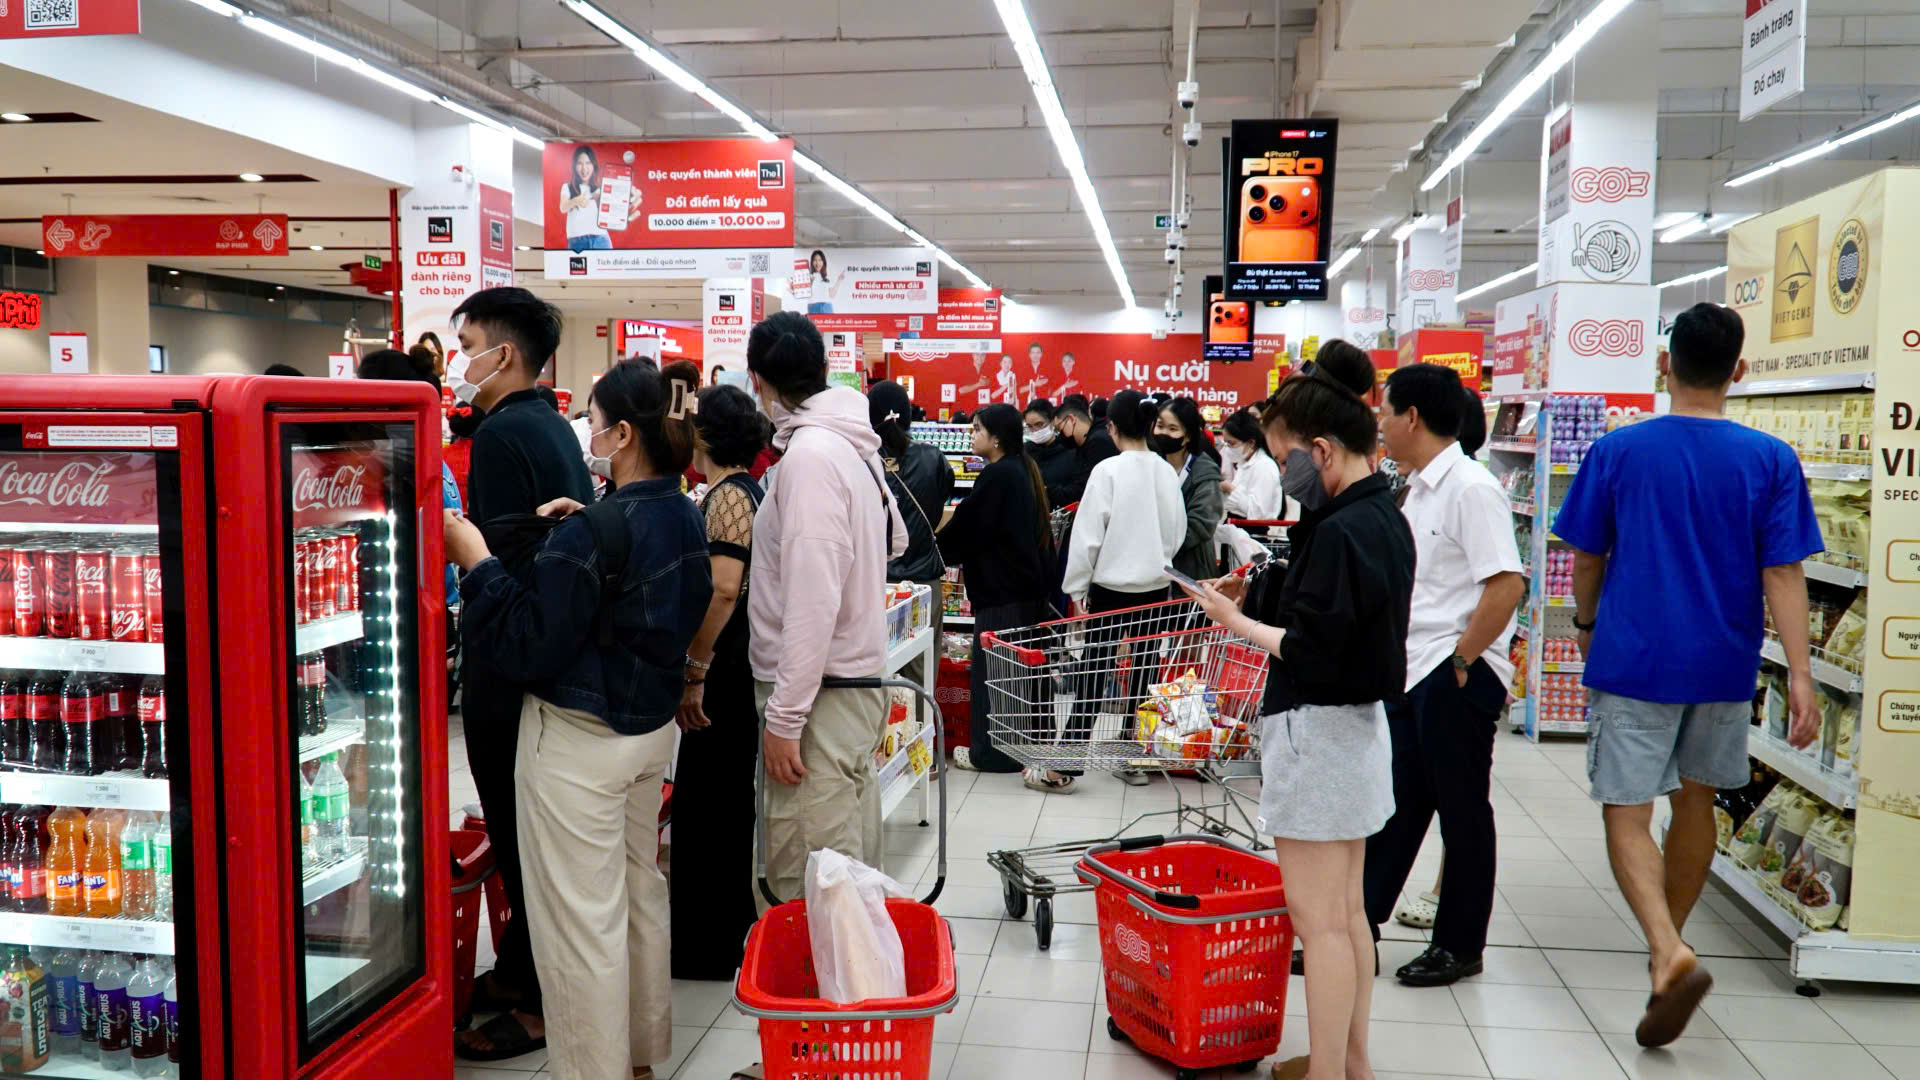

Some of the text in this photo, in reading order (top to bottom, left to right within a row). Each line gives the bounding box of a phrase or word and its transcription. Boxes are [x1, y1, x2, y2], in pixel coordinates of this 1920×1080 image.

[1766, 67, 1786, 89] chay
[648, 168, 757, 181] Đặc quyền thành viên
[1242, 157, 1323, 176] PRO
[666, 194, 768, 209] Đổi điểm lấy quà
[687, 217, 709, 226] điểm
[718, 215, 765, 227] 10.000
[420, 252, 460, 264] Ưu đãi
[411, 271, 472, 283] dành riêng
[420, 286, 465, 297] cho bạn
[1734, 276, 1765, 305] OCOP
[1569, 319, 1643, 357] GO!
[61, 348, 73, 362] 5
[1765, 357, 1780, 371] NAM
[1786, 352, 1821, 370] SPECIALTY
[1823, 350, 1833, 366] OF
[1834, 345, 1870, 364] VIETNAM
[336, 365, 344, 376] 7
[1114, 360, 1210, 386] Nụ cười
[1198, 387, 1238, 404] hàng
[0, 460, 116, 507] Coca-Cola
[292, 464, 366, 512] Coca-Cola
[1890, 702, 1915, 712] Chứng
[100, 993, 114, 1040] AQUARIUS
[132, 1000, 145, 1048] AQUARIUS
